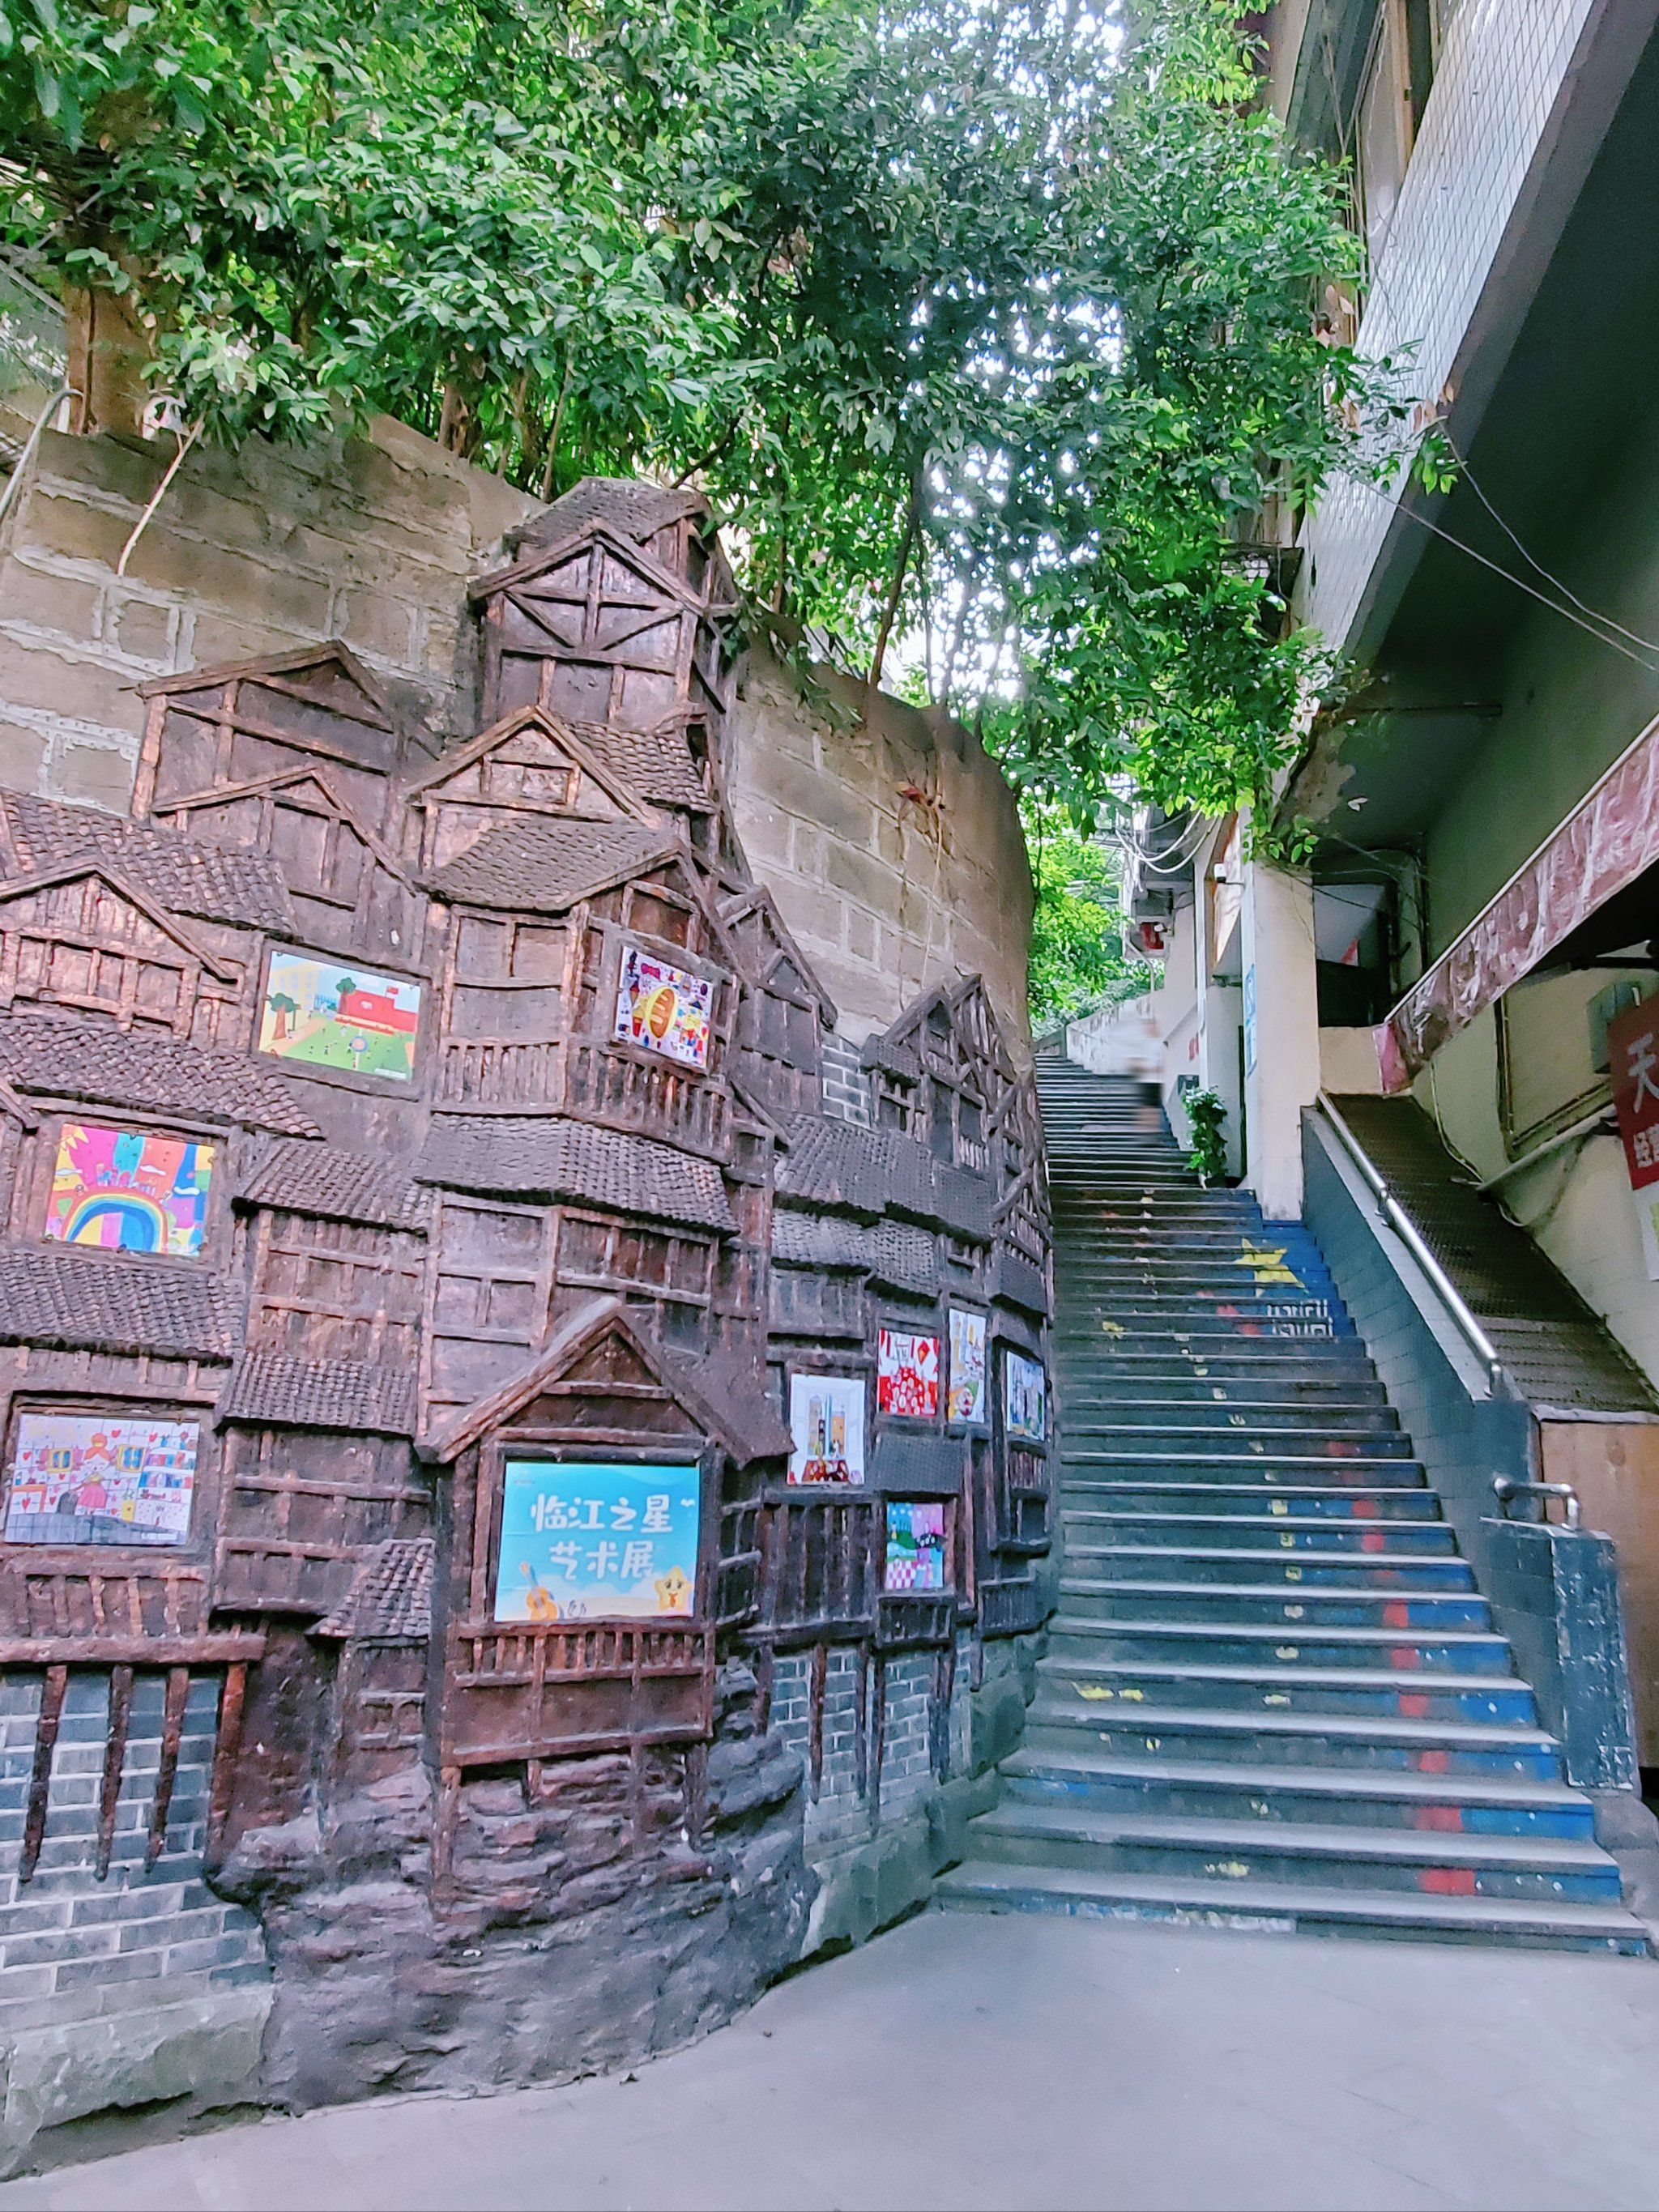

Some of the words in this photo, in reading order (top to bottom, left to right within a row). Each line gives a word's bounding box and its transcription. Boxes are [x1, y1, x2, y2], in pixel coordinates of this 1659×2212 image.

[530, 1492, 673, 1533] 临江之星
[548, 1540, 655, 1580] 艺术展
